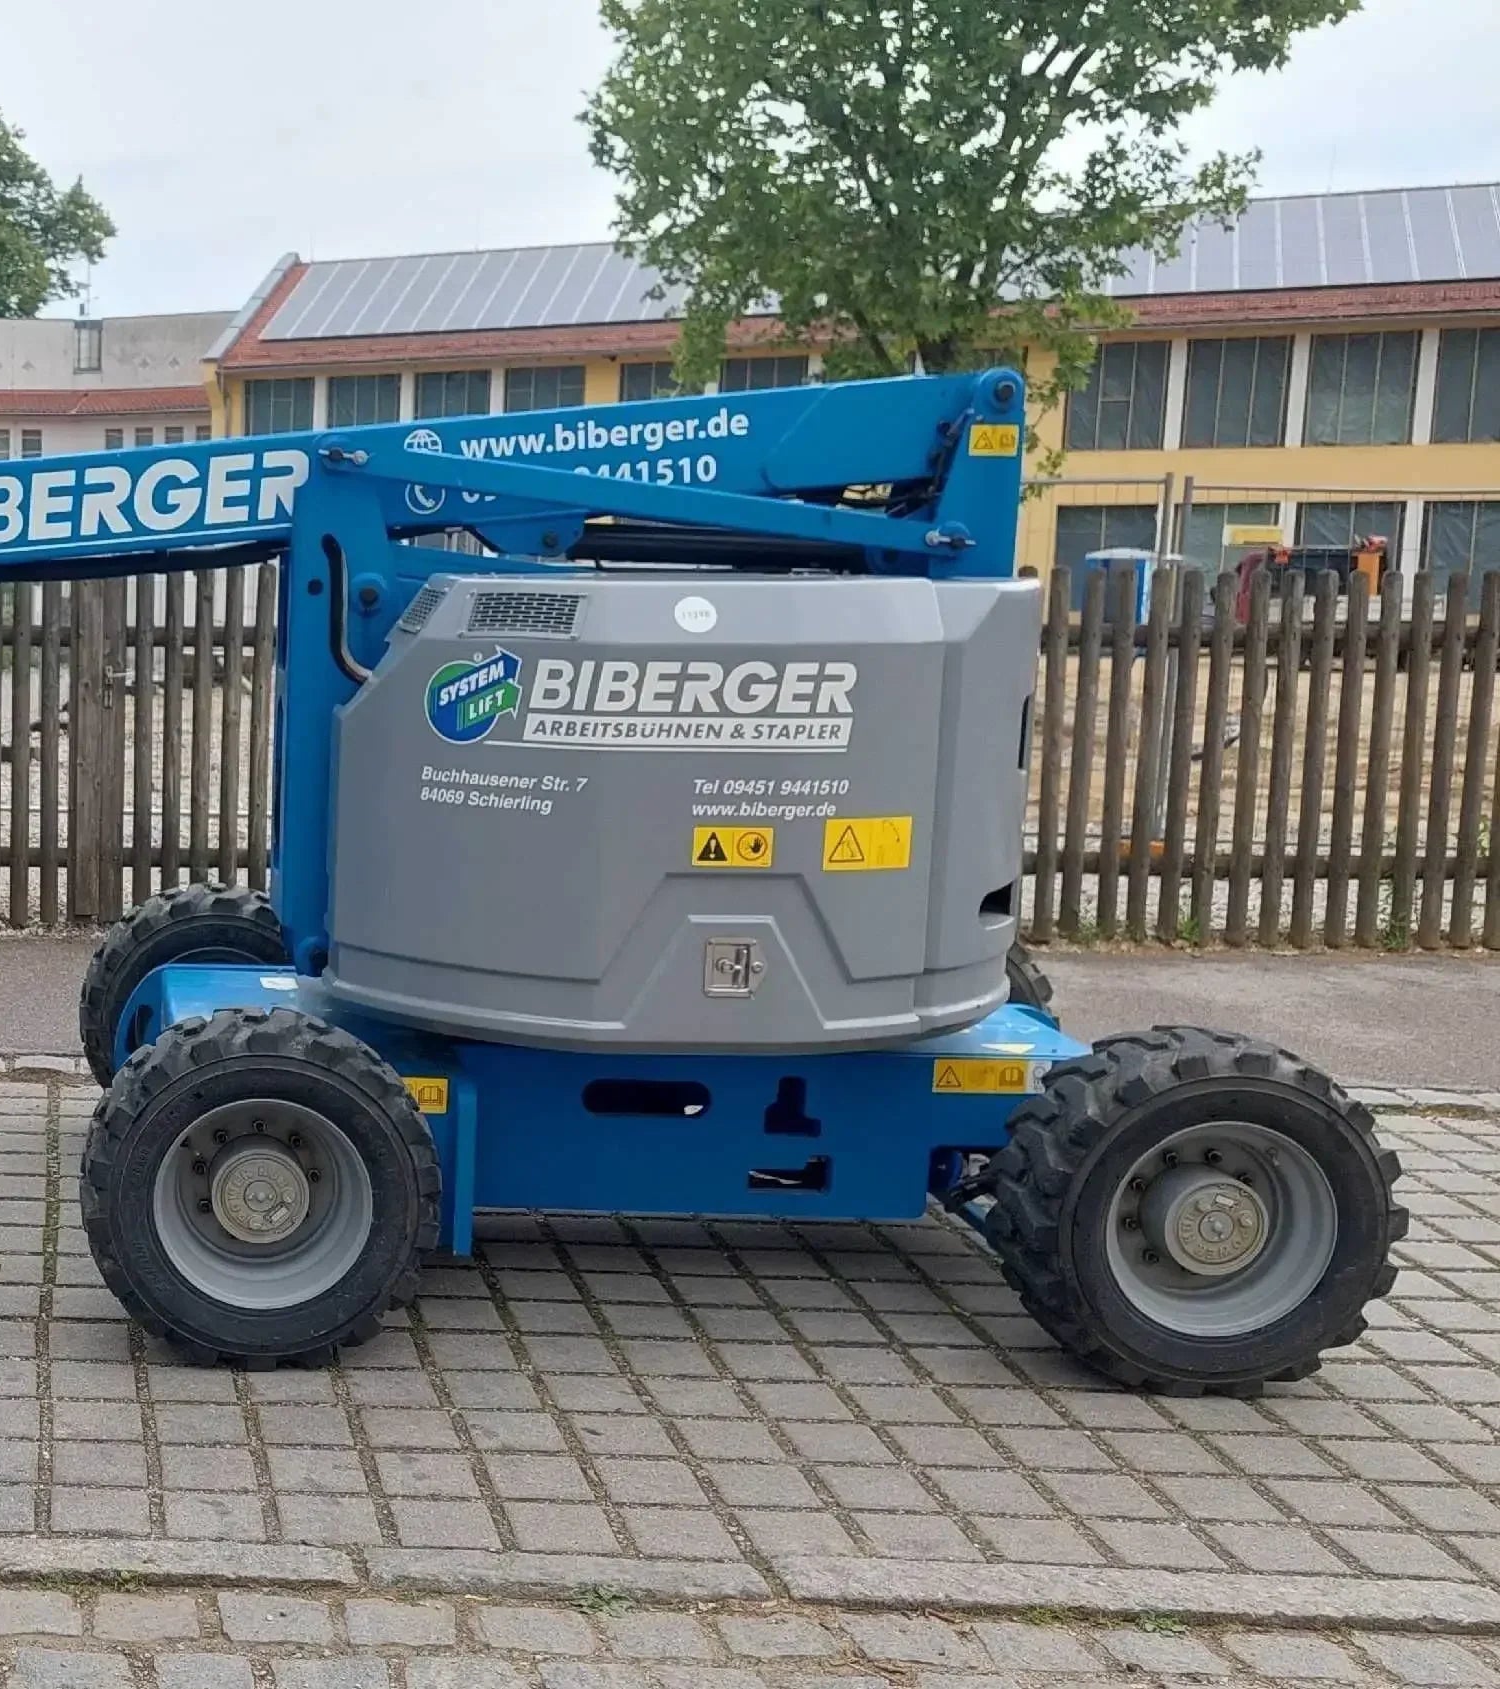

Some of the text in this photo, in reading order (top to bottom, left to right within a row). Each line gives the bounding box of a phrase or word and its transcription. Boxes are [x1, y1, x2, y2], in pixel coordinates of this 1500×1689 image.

[460, 408, 750, 459] www.biberger.de
[438, 660, 504, 706] SYSTEM
[529, 659, 858, 714] BIBERGER
[469, 689, 506, 720] LIFT
[532, 719, 841, 740] ARBEITSBÜHNEN & STAPLER
[421, 765, 588, 792] Buchhausener Str. 7
[693, 779, 850, 795] Tel 09451 9441510
[420, 786, 553, 816] 84069 Schierling
[692, 801, 837, 820] www.biberger.de
